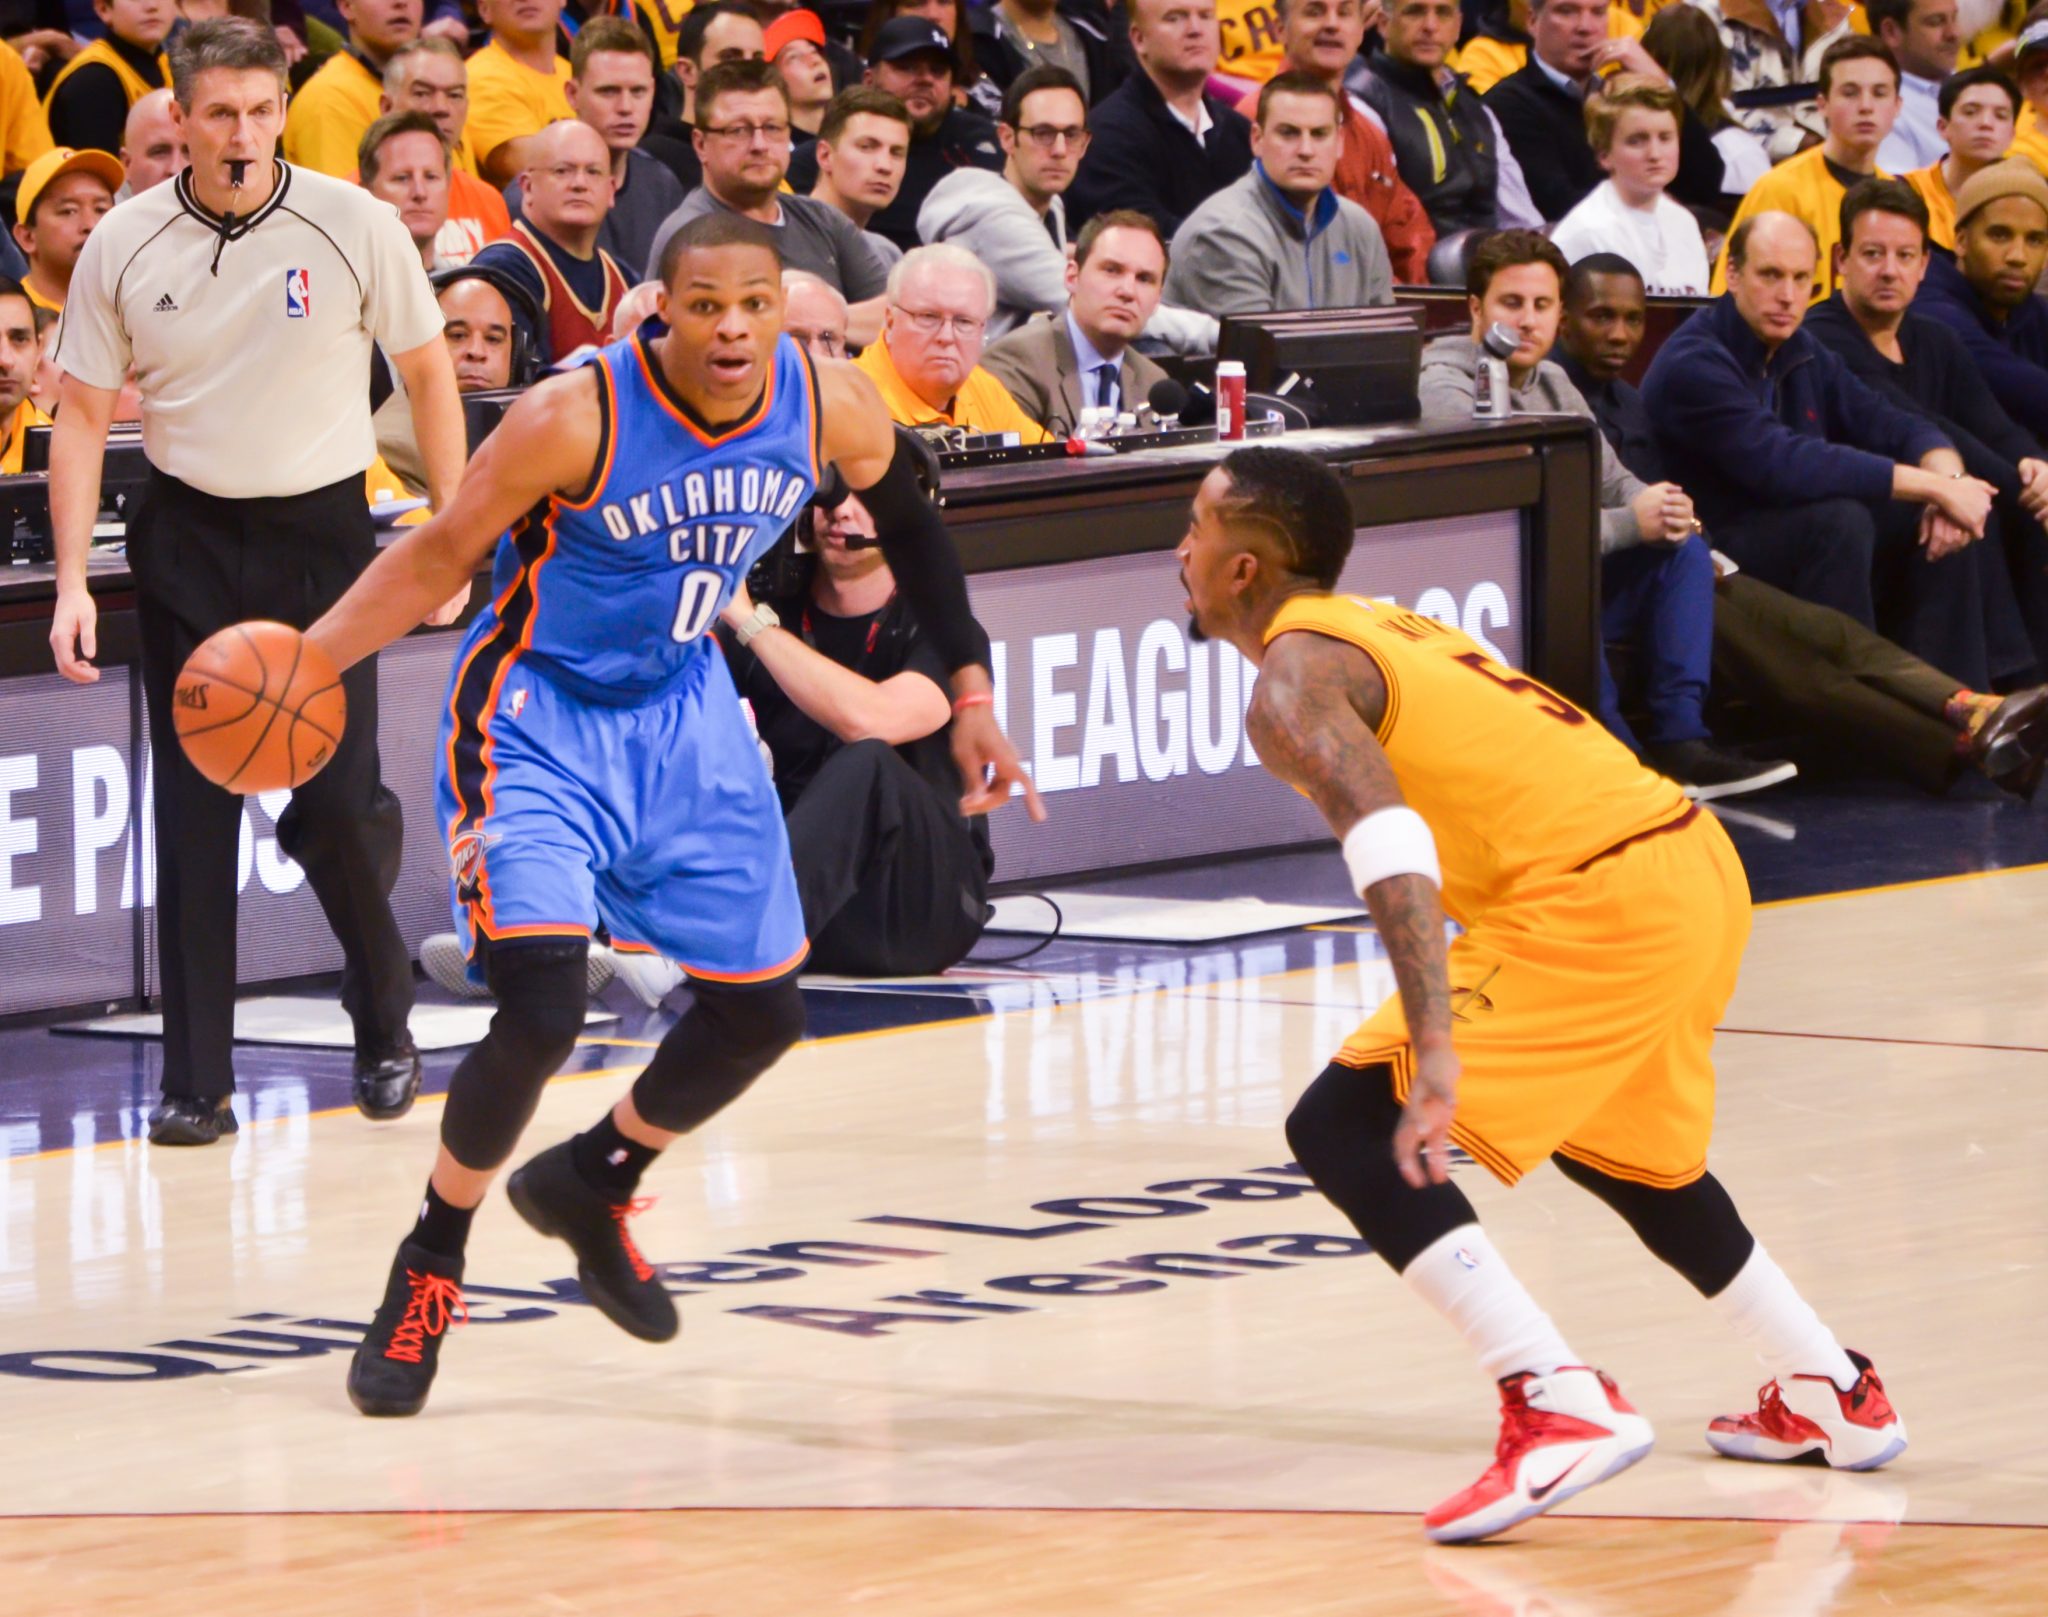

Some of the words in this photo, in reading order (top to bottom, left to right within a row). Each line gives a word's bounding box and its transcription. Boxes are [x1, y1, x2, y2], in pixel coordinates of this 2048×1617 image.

[153, 304, 178, 312] adidas
[288, 307, 304, 316] NBA
[602, 467, 806, 541] OKLAHOMA
[670, 524, 756, 566] CITY
[671, 569, 723, 643] 0
[988, 618, 1260, 797] LEAGU
[1449, 652, 1586, 726] 5
[722, 1233, 1374, 1338] Arena
